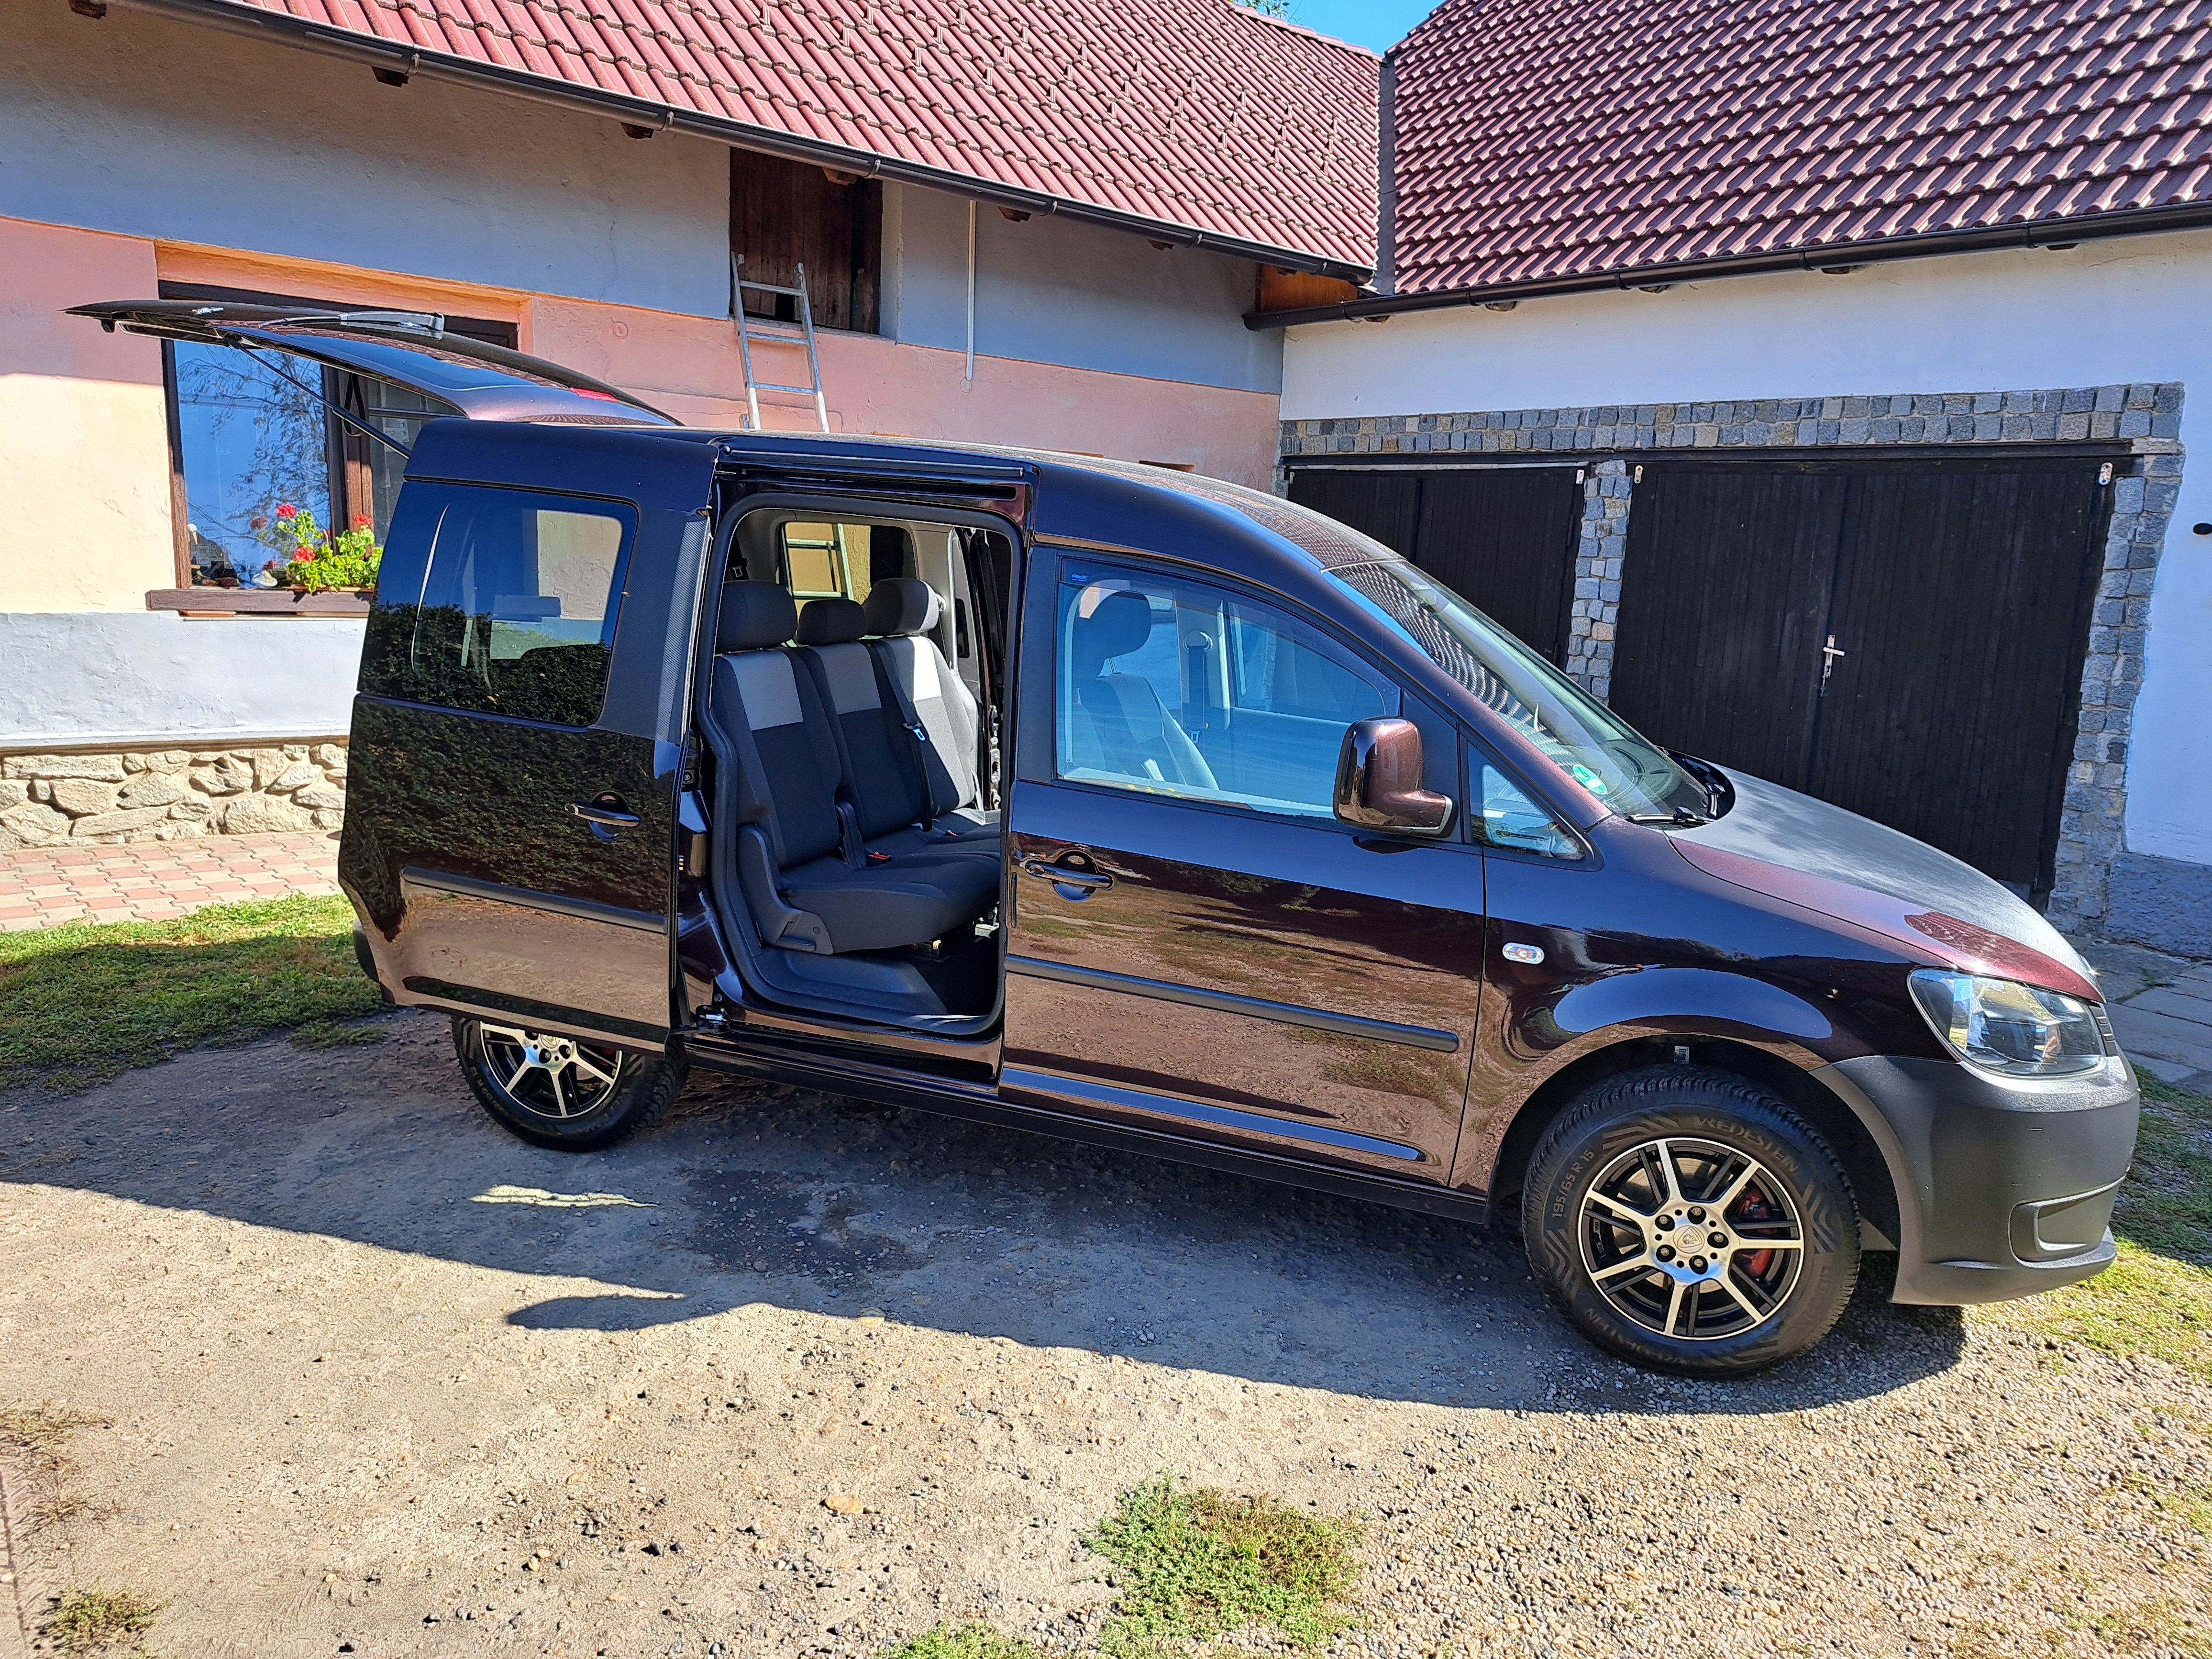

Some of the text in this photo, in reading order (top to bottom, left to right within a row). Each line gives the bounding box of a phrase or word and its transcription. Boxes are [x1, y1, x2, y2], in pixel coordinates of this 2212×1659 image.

[1693, 1115, 1800, 1172] VREDESTEIN
[1552, 1149, 1595, 1217] 195/65 R 15
